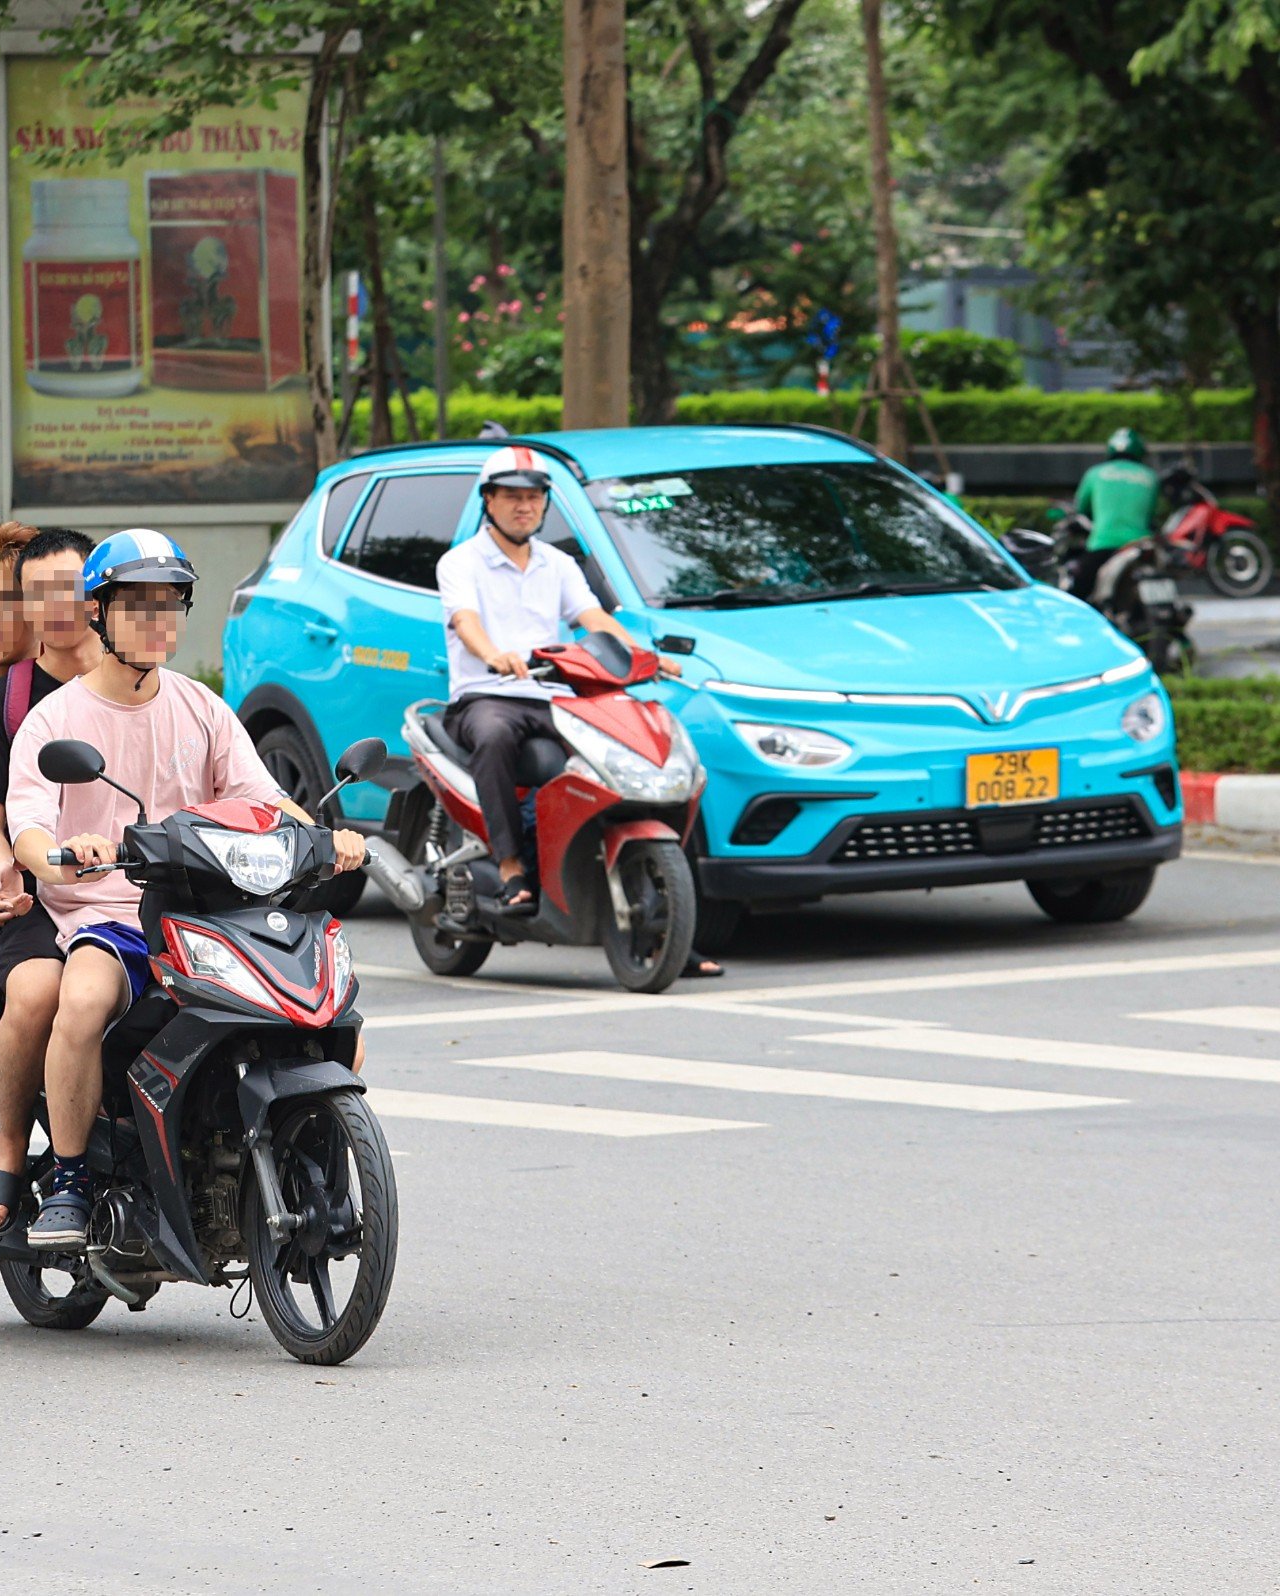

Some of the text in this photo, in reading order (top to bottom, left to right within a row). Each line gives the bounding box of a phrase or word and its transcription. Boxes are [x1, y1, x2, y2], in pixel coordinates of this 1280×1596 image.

[616, 496, 673, 513] TAXI
[994, 751, 1032, 777] 29K
[976, 776, 1049, 802] 008.22
